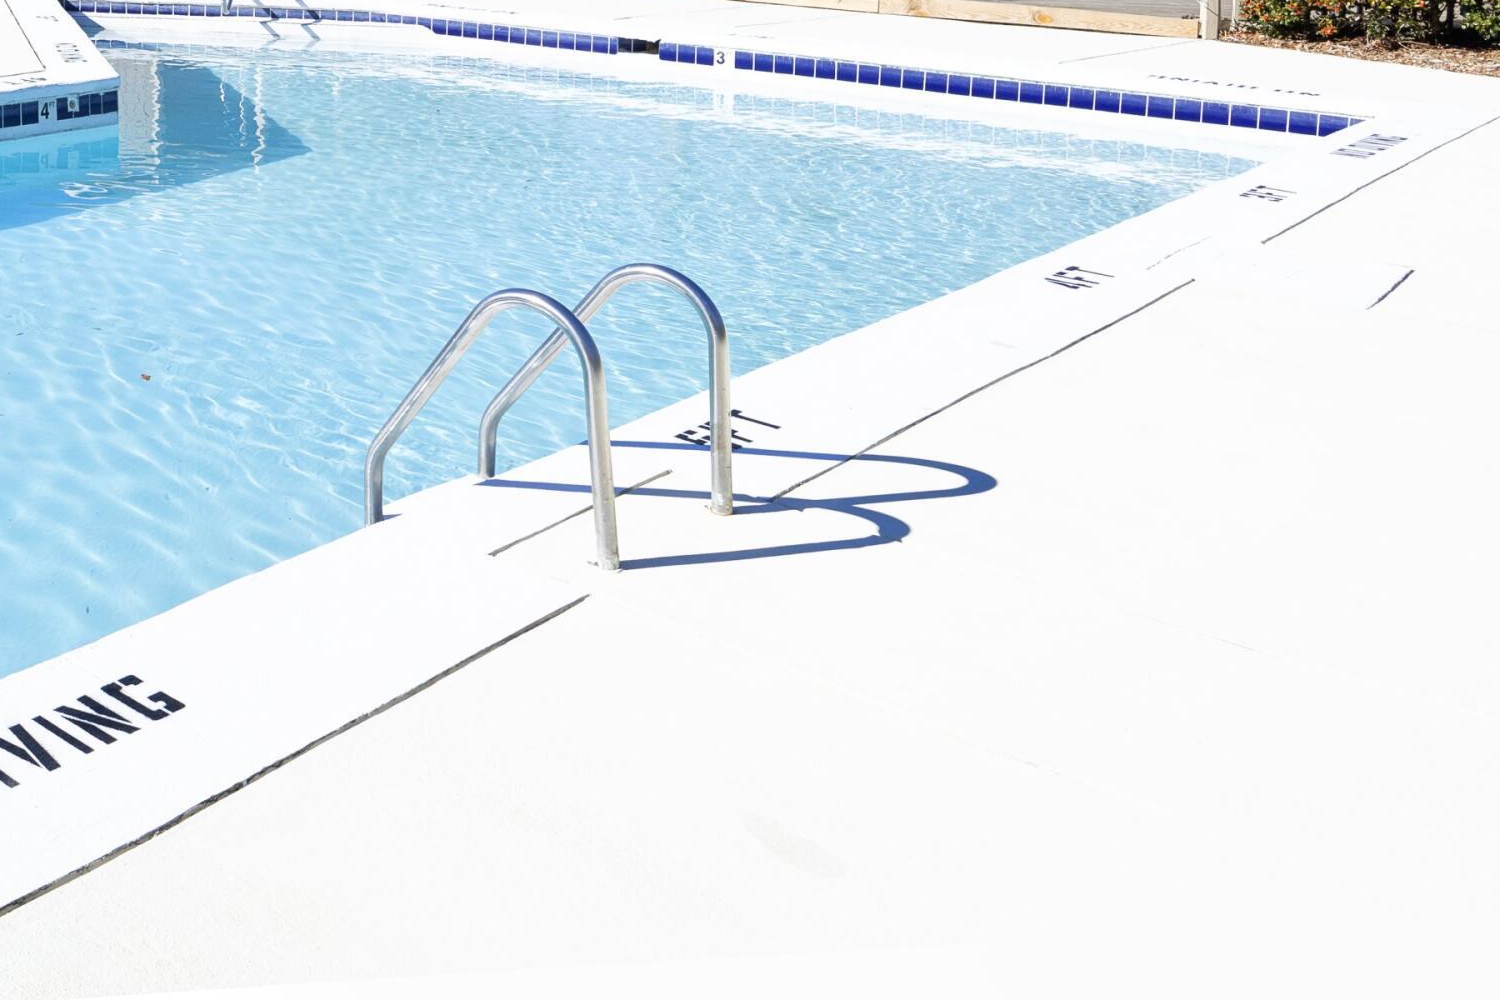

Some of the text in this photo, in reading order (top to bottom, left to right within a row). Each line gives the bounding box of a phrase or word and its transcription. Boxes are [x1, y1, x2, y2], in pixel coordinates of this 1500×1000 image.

[716, 51, 726, 65] 3
[1238, 184, 1297, 203] 3FT
[1043, 265, 1115, 290] 4FT
